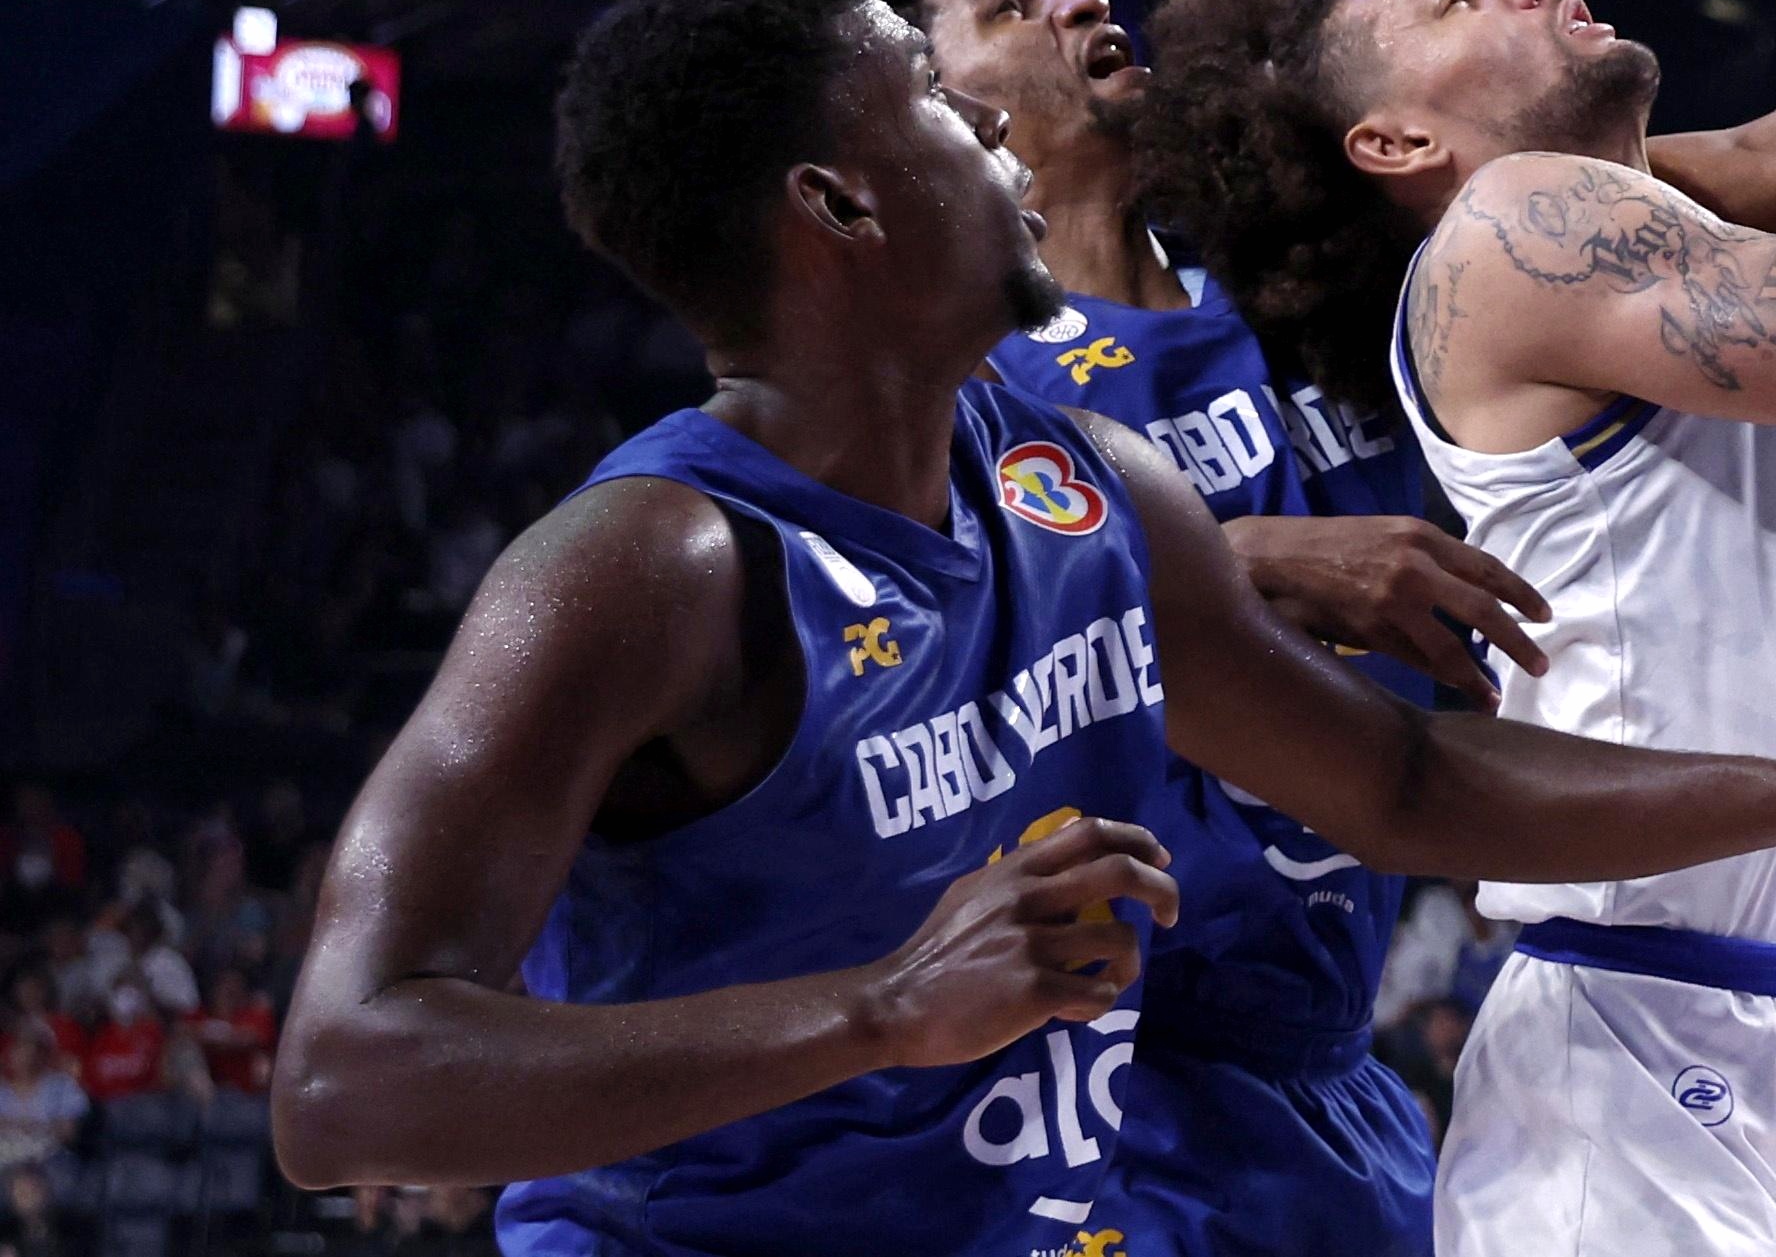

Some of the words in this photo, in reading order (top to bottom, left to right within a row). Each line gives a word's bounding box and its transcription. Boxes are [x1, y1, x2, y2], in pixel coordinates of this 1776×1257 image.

[1145, 388, 1276, 496] ABO
[855, 701, 1017, 840] CABO
[989, 606, 1165, 768] VERDE
